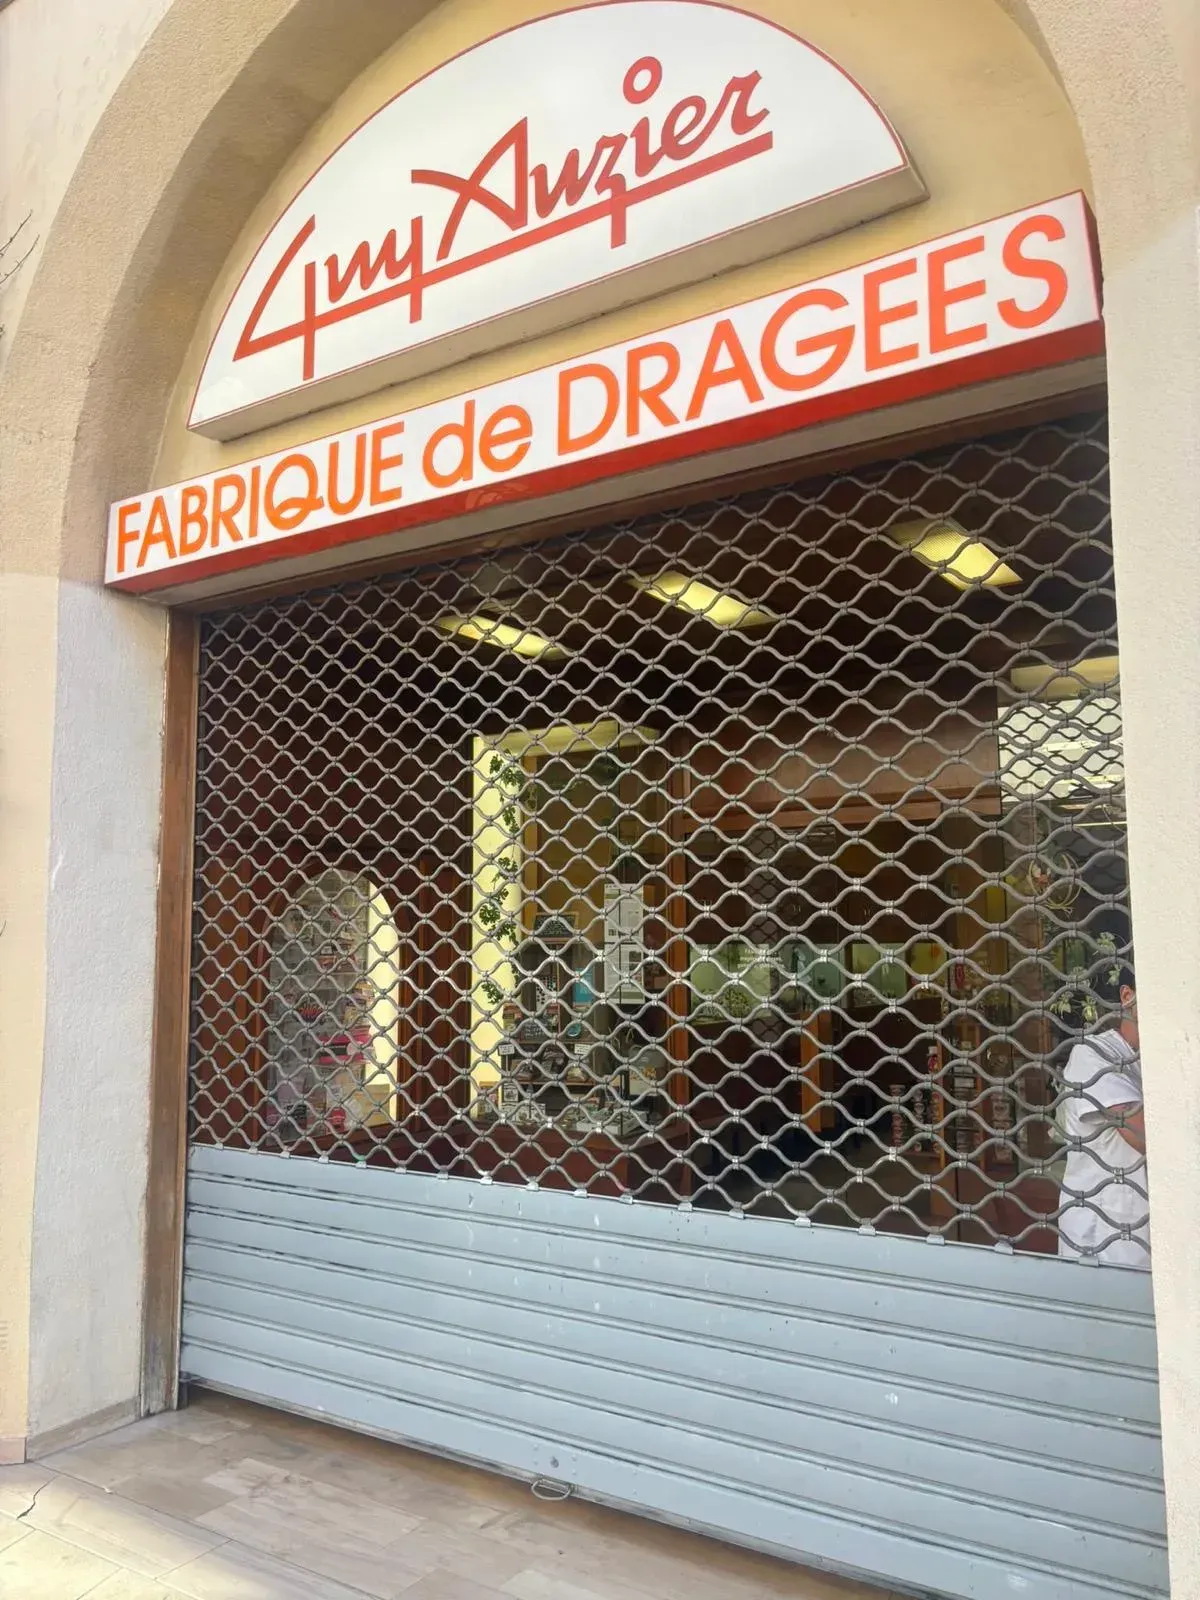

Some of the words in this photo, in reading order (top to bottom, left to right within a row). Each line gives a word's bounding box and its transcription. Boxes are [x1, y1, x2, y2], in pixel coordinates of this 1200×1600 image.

[232, 214, 425, 381] Guy
[411, 56, 771, 249] Auzier
[116, 421, 405, 574] FABRIQUE
[421, 399, 533, 489] de
[556, 214, 1069, 457] DRAGEES
